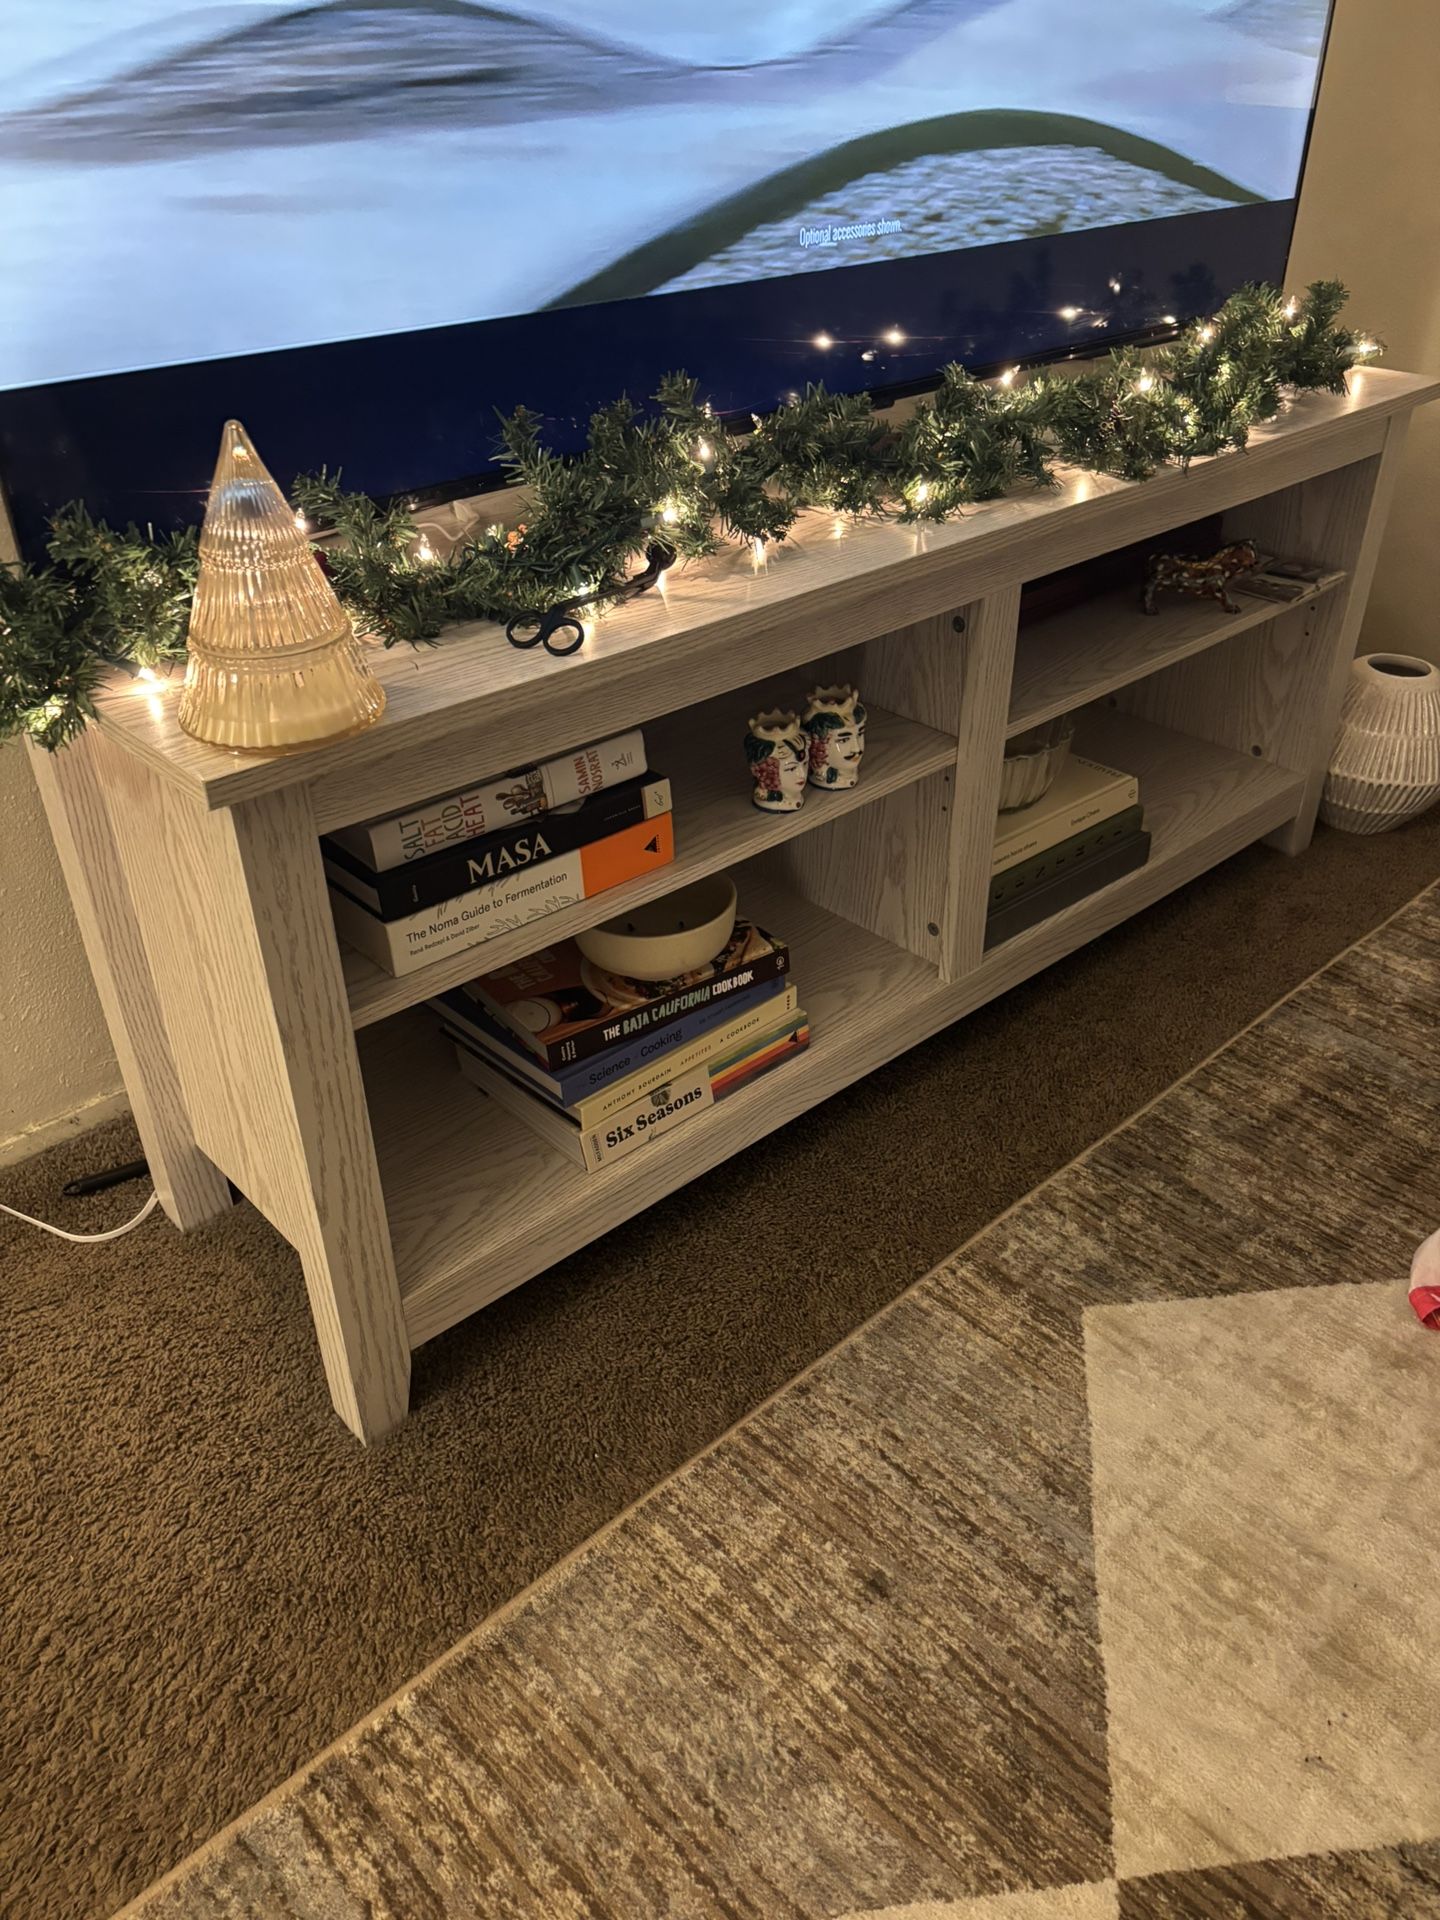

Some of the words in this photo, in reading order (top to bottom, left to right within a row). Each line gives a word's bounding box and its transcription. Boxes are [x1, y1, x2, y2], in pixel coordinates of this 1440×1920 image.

[800, 225, 831, 248] Optional
[833, 222, 876, 241] accessories
[573, 756, 591, 794] SAMIN
[586, 750, 603, 791] NOSRAT
[421, 818, 445, 848] FAT
[442, 805, 466, 840] ACID
[460, 795, 485, 838] HEAT
[399, 820, 425, 859] SALT
[467, 833, 552, 884] MASA
[406, 931, 427, 943] The
[429, 916, 459, 935] Noma
[461, 904, 490, 921] Guide
[493, 898, 502, 908] to
[505, 872, 568, 903] Fermentation
[603, 1024, 620, 1041] THE
[623, 1012, 650, 1035] BAJA
[652, 985, 711, 1021] CALIFORNIA
[712, 970, 754, 995] COOKBOOK
[589, 1058, 631, 1085] Science
[641, 1028, 683, 1057] Cooking
[602, 1088, 636, 1111] ANTHONY
[638, 1068, 672, 1090] BOURDAIN
[680, 1045, 711, 1066] APPETITES
[726, 1017, 760, 1040] COOKBOOK
[605, 1124, 635, 1148] Six
[636, 1087, 702, 1132] Seasons
